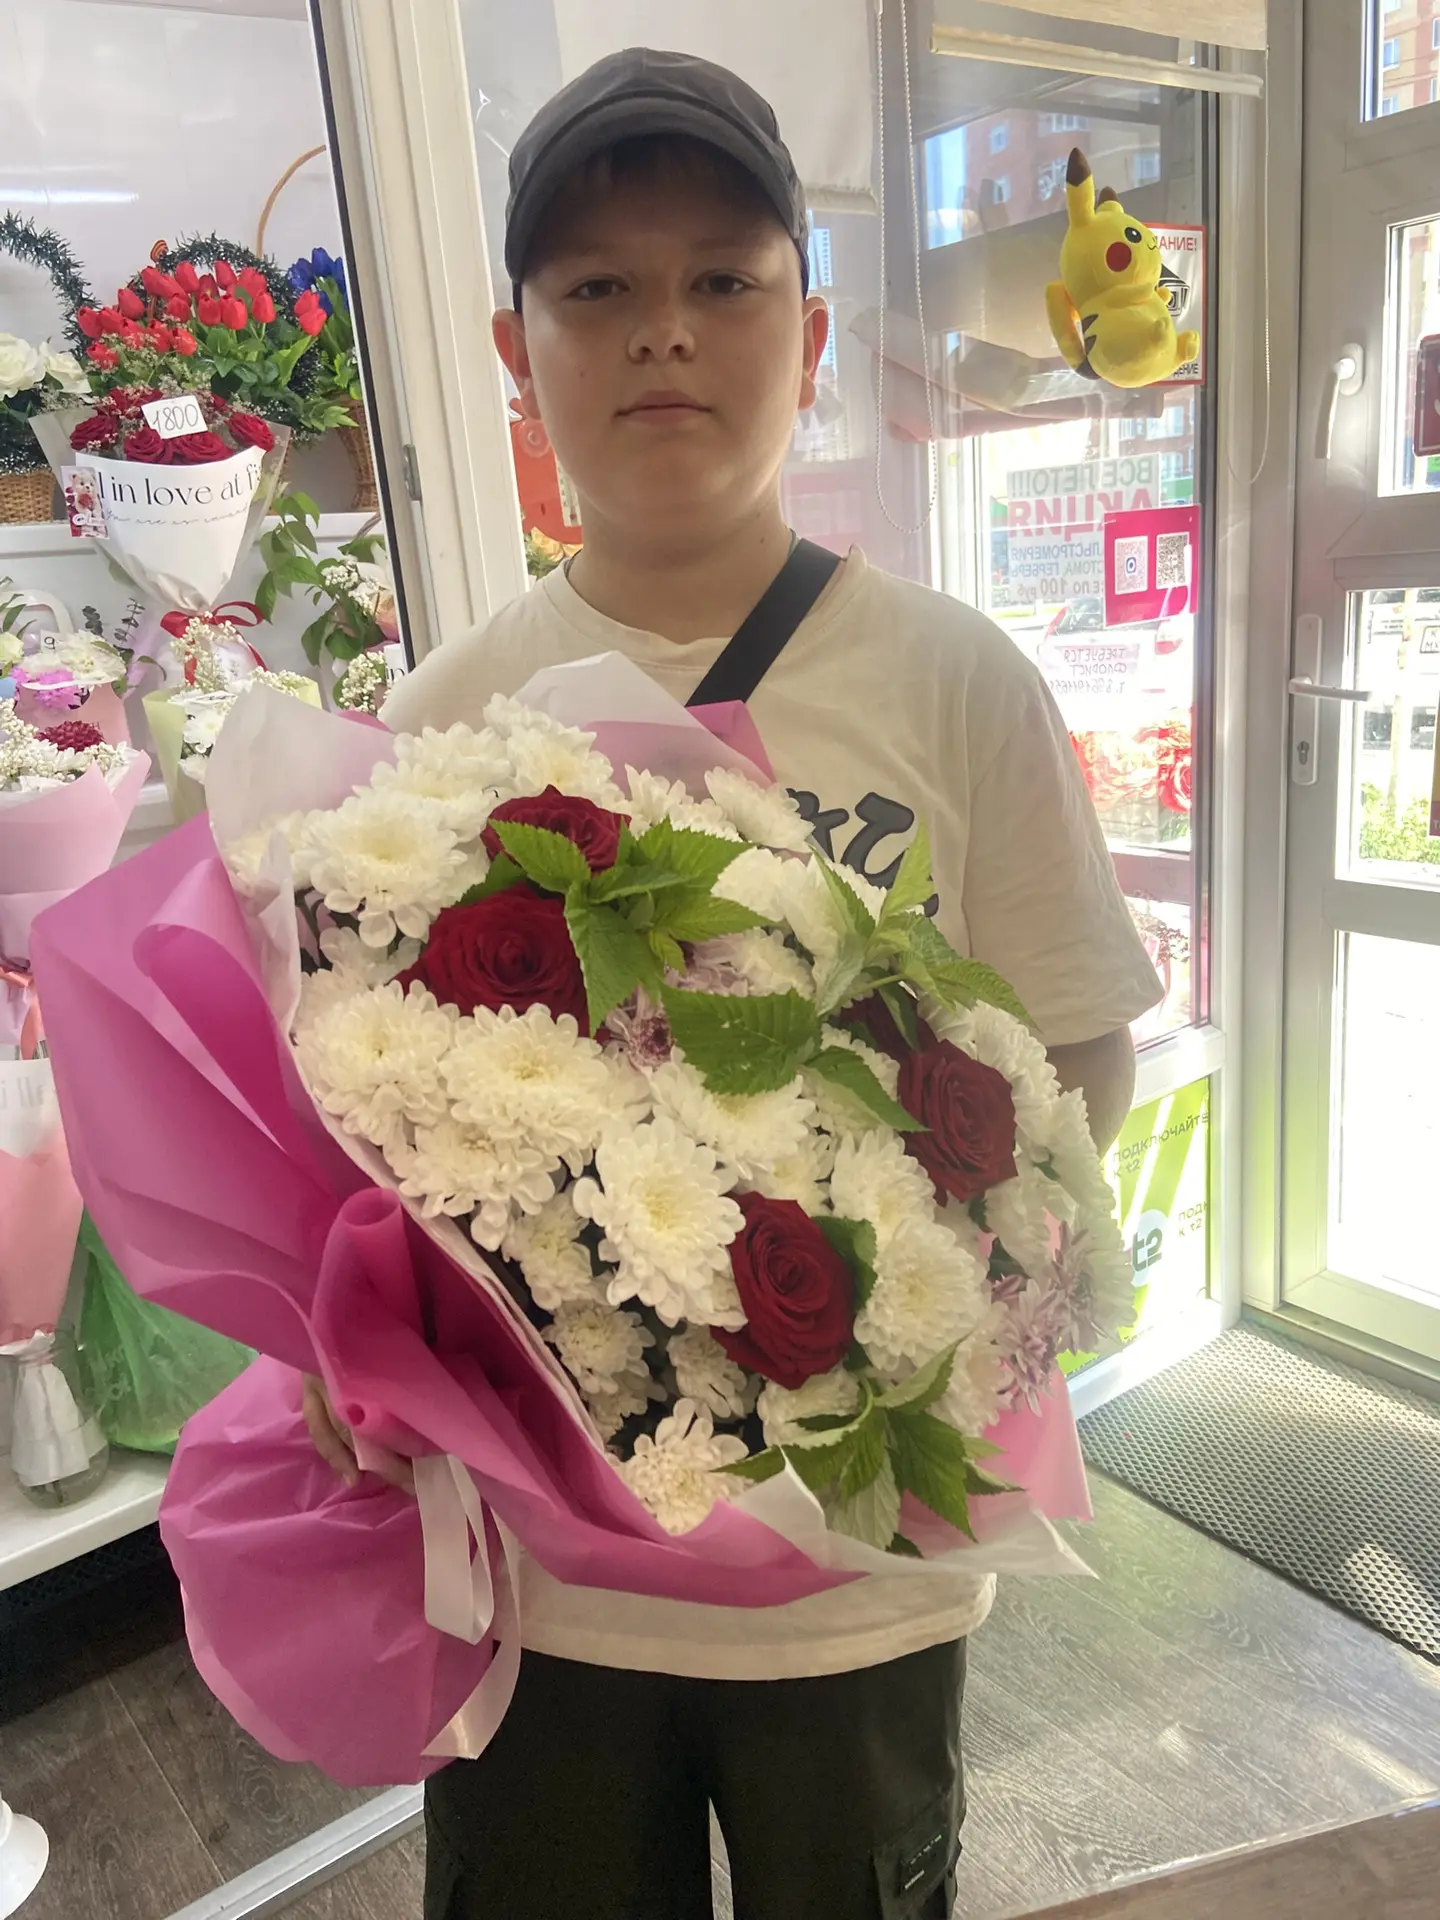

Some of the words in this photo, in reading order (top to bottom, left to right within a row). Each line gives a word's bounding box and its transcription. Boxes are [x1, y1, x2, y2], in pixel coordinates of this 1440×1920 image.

[1155, 235, 1197, 251] АНИЕ!
[152, 403, 199, 433] 1800
[111, 476, 137, 504] in
[145, 478, 214, 506] love
[220, 476, 244, 501] at
[1131, 1227, 1163, 1272] t2
